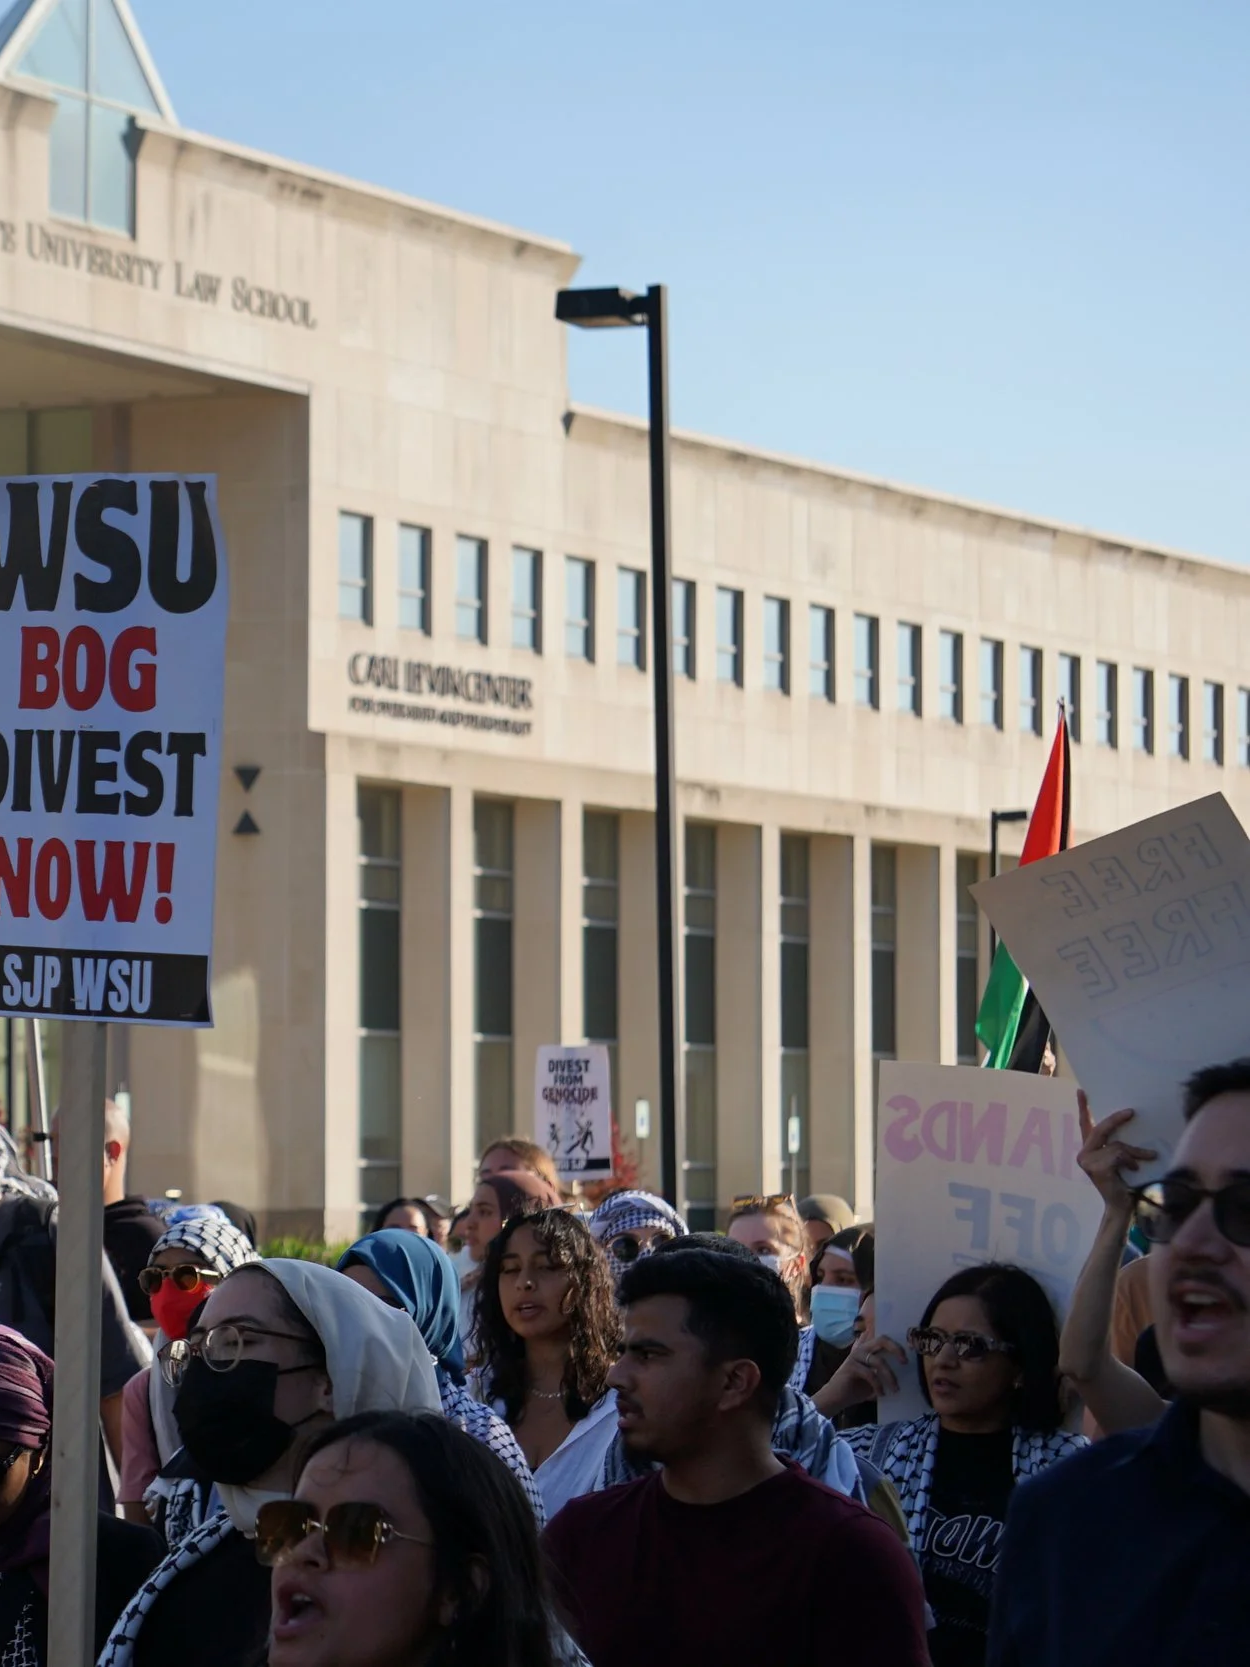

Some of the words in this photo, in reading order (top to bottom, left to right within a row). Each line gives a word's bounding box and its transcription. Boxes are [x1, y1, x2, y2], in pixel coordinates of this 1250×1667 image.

[18, 625, 157, 713] BOG
[2, 953, 62, 1009] SJP
[72, 957, 153, 1014] WSU
[548, 1059, 591, 1074] DIVEST
[553, 1073, 584, 1086] FROM
[542, 1086, 599, 1103] GENOCIDE
